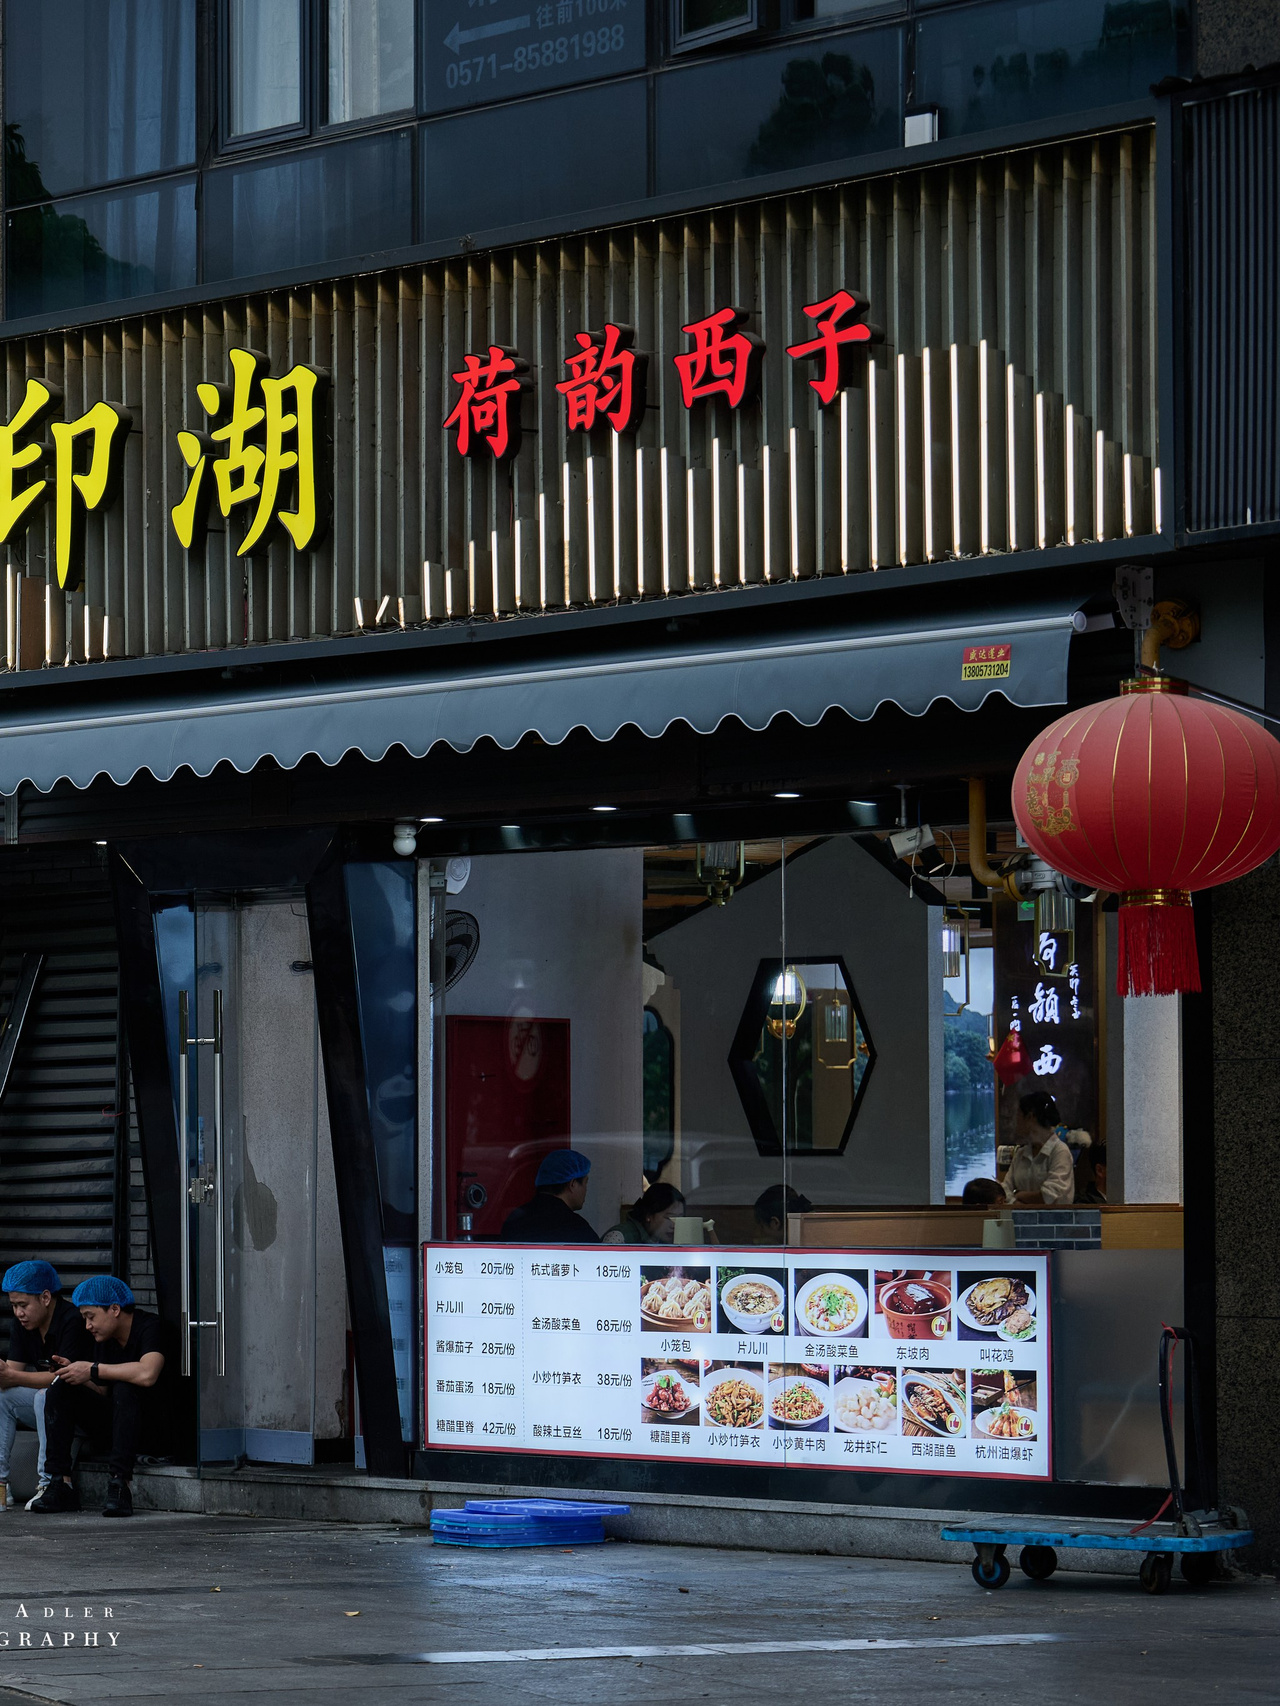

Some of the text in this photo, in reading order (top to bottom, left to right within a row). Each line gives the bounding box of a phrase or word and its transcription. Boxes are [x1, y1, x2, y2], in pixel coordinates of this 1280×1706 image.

[446, 23, 625, 89] 0571-85881988
[442, 289, 873, 461] 荷韵西子
[963, 663, 1009, 678] 13805731204
[434, 1261, 515, 1276] 小笼包 20元/份
[531, 1263, 631, 1279] 杭式酱萝卜 18元/份
[435, 1300, 515, 1316] 片儿川 20元/份
[531, 1316, 632, 1333] 金汤酸菜鱼 68元/份
[436, 1339, 516, 1356] 酱爆茄子 28元/份
[660, 1338, 692, 1353] 小笼包
[737, 1341, 768, 1355] 片儿川
[804, 1343, 859, 1358] 金汤酸菜鱼
[896, 1346, 929, 1361] 东坡肉
[980, 1348, 1014, 1363] 叫花鸡
[532, 1370, 582, 1385] 小炒竹笋衣
[597, 1373, 633, 1387] 38元/份
[436, 1379, 516, 1396] 番茄蛋汤 18元/份
[436, 1419, 517, 1436] 糖醋里脊 42元/份
[532, 1424, 633, 1442] 酸辣土豆丝 18元/份
[650, 1430, 691, 1445] 糖醋里脊
[708, 1432, 760, 1448] 小炒竹笋衣
[772, 1436, 826, 1452] 小炒黄牛肉
[843, 1439, 888, 1454] 龙井虾仁
[911, 1442, 957, 1458] 西湖醋鱼
[975, 1444, 1033, 1462] 杭州油爆虾
